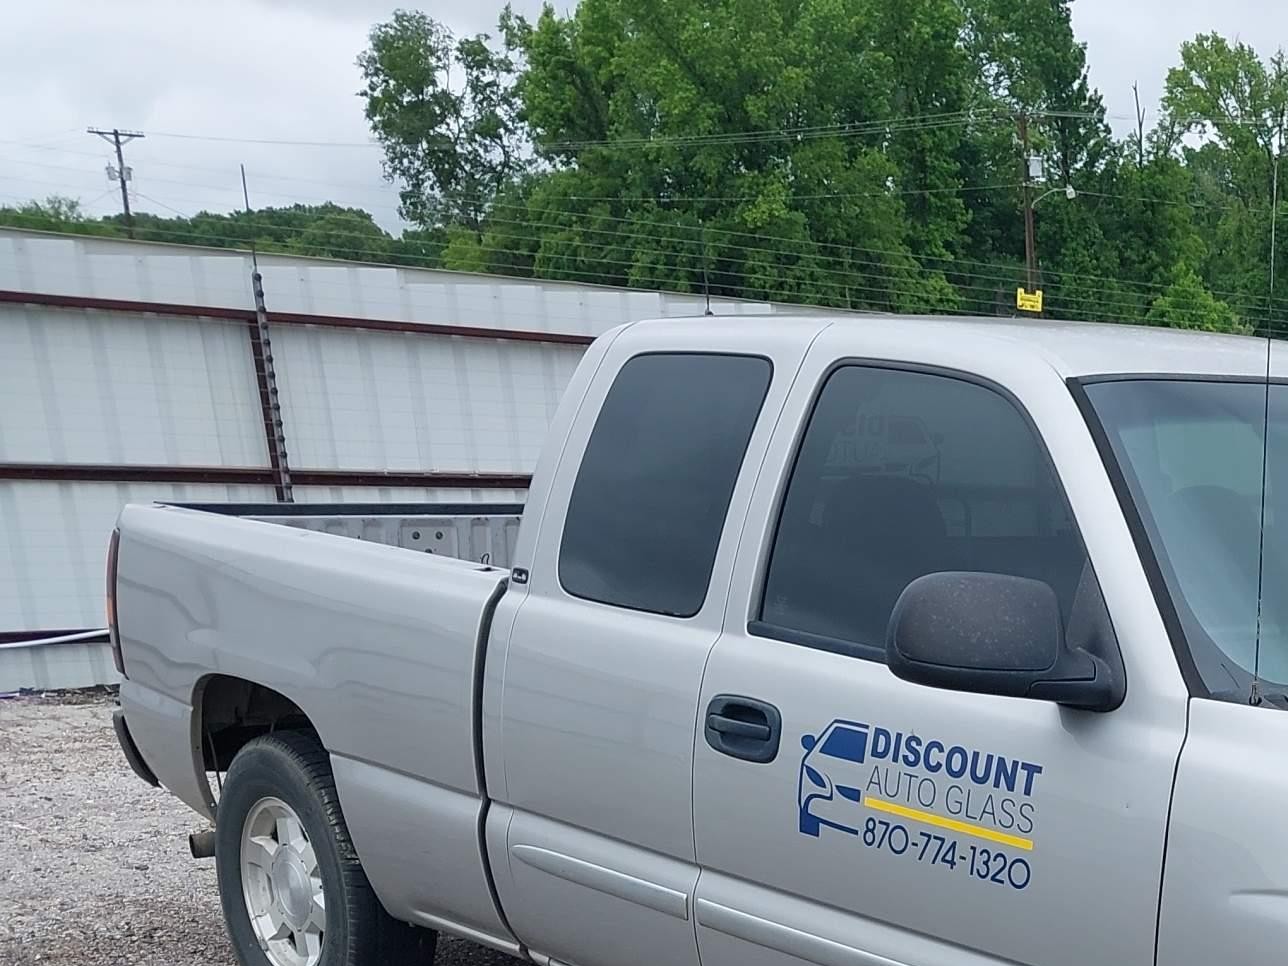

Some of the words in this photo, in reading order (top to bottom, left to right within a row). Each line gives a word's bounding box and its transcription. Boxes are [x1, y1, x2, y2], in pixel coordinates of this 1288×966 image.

[870, 727, 1043, 797] DISCOUNT
[866, 765, 937, 809] AUTO
[945, 784, 1035, 834] GLASS
[862, 817, 1031, 890] 870-774-1320
